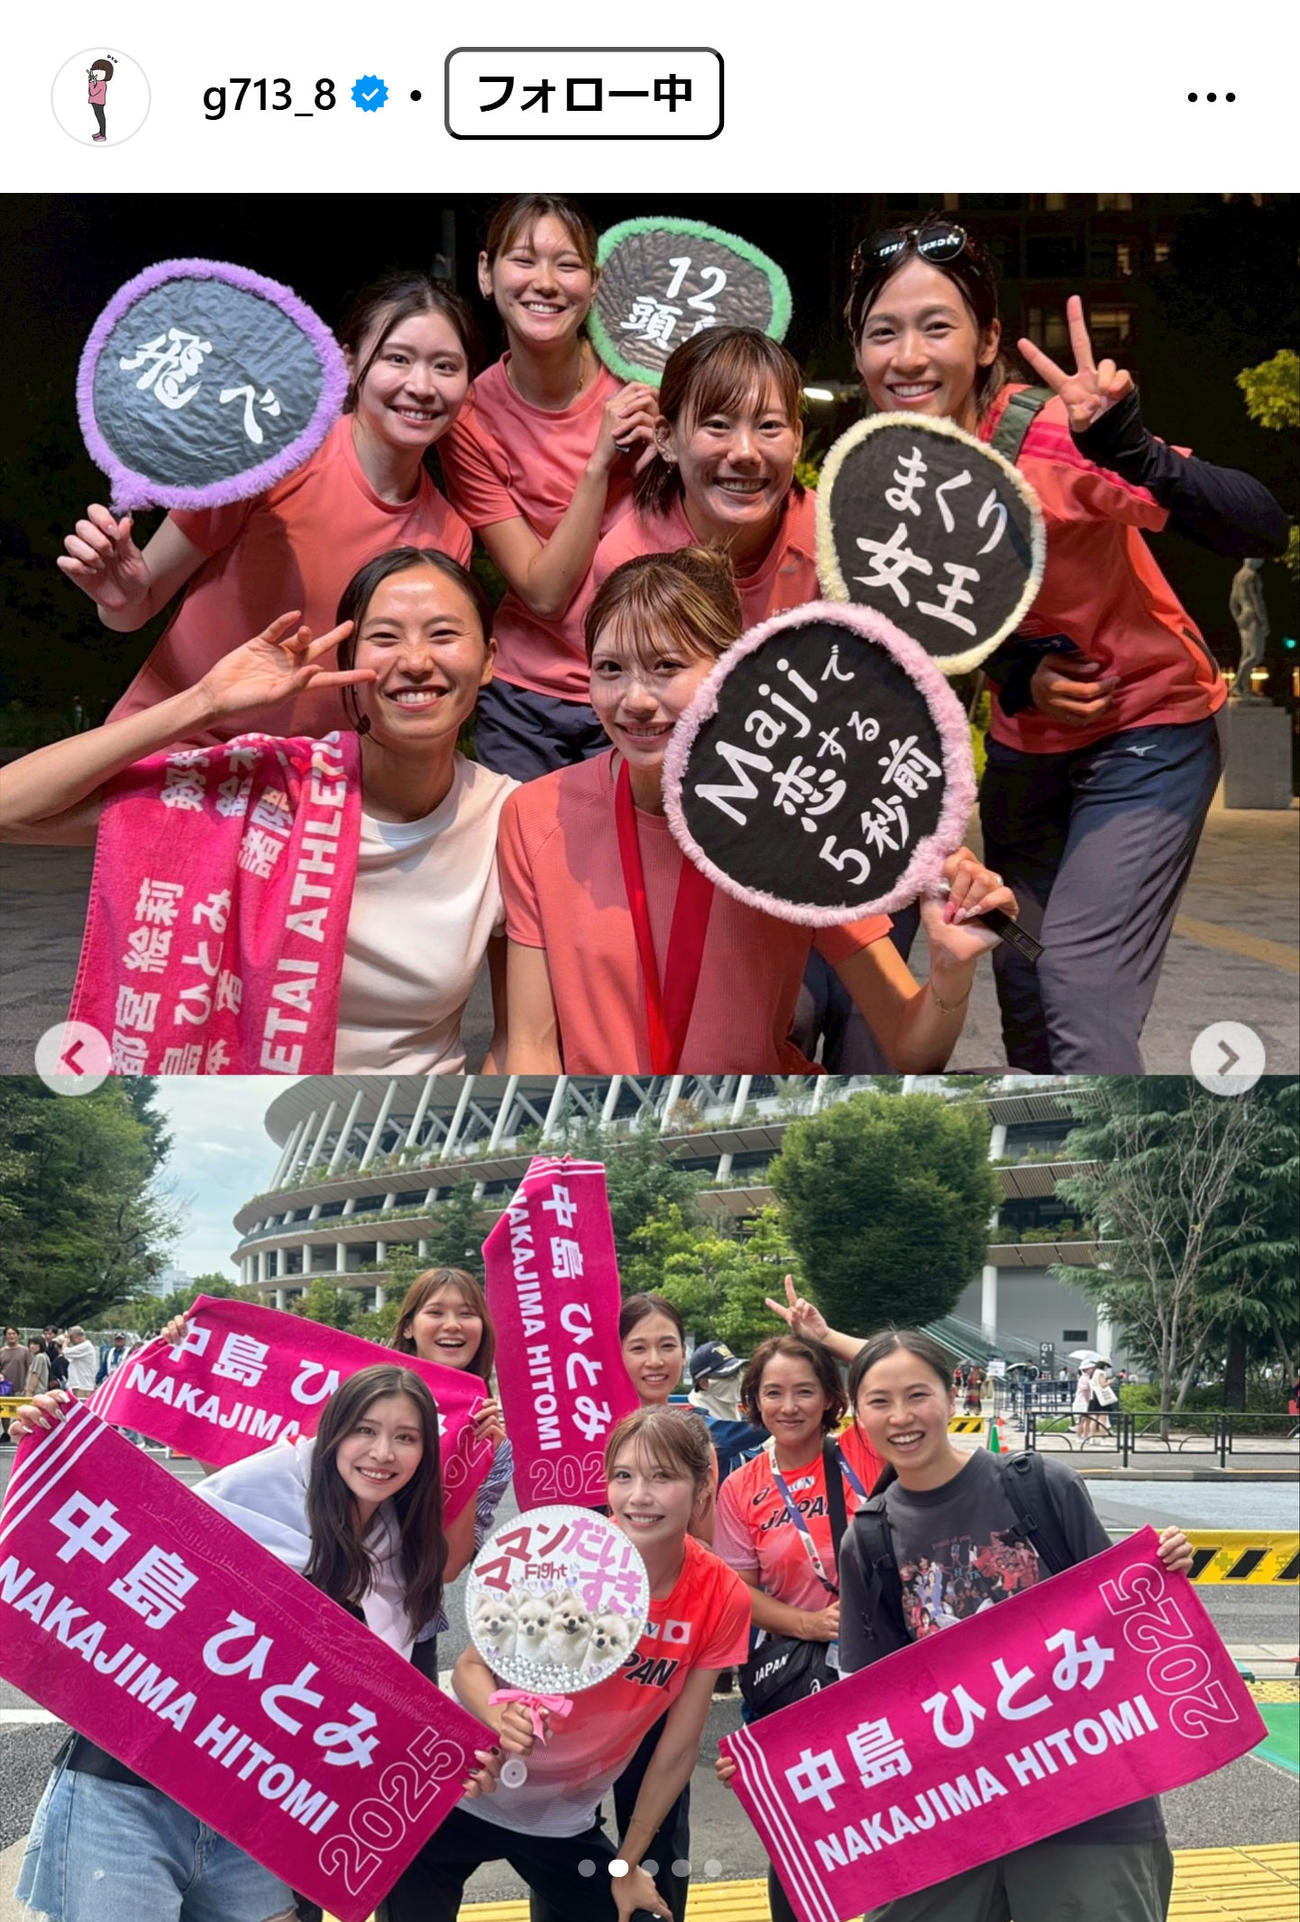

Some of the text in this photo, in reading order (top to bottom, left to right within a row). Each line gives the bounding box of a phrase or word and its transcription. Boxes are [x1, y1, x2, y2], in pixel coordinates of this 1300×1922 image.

[620, 296, 717, 350] 頭
[665, 256, 728, 312] 12
[118, 327, 282, 445] 飛べ
[884, 446, 1007, 556] まくり
[852, 522, 981, 637] 女王
[771, 710, 881, 833] 恋する
[818, 735, 943, 886] 5秒前
[121, 877, 185, 975] 絵莉
[173, 888, 232, 1027] ひとみ
[259, 957, 321, 1075] ETAI
[168, 1316, 271, 1388] 中島
[541, 1183, 613, 1443] 中島 ひとみ
[526, 1344, 563, 1451] HITOMI
[528, 1450, 608, 1501] 202
[760, 1495, 830, 1531] JAPA
[49, 1489, 381, 1769] 中島 ひとみ
[524, 1560, 569, 1581] Fight
[0, 1554, 340, 1835] NAKAJIMA HITOMI
[753, 1653, 789, 1686] JAPAN
[1098, 1562, 1240, 1739] 2025
[783, 1628, 1115, 1813] 中島 ひとみ
[318, 1725, 466, 1896] 2025
[813, 1694, 1160, 1873] NAKAJIMA HITOMI
